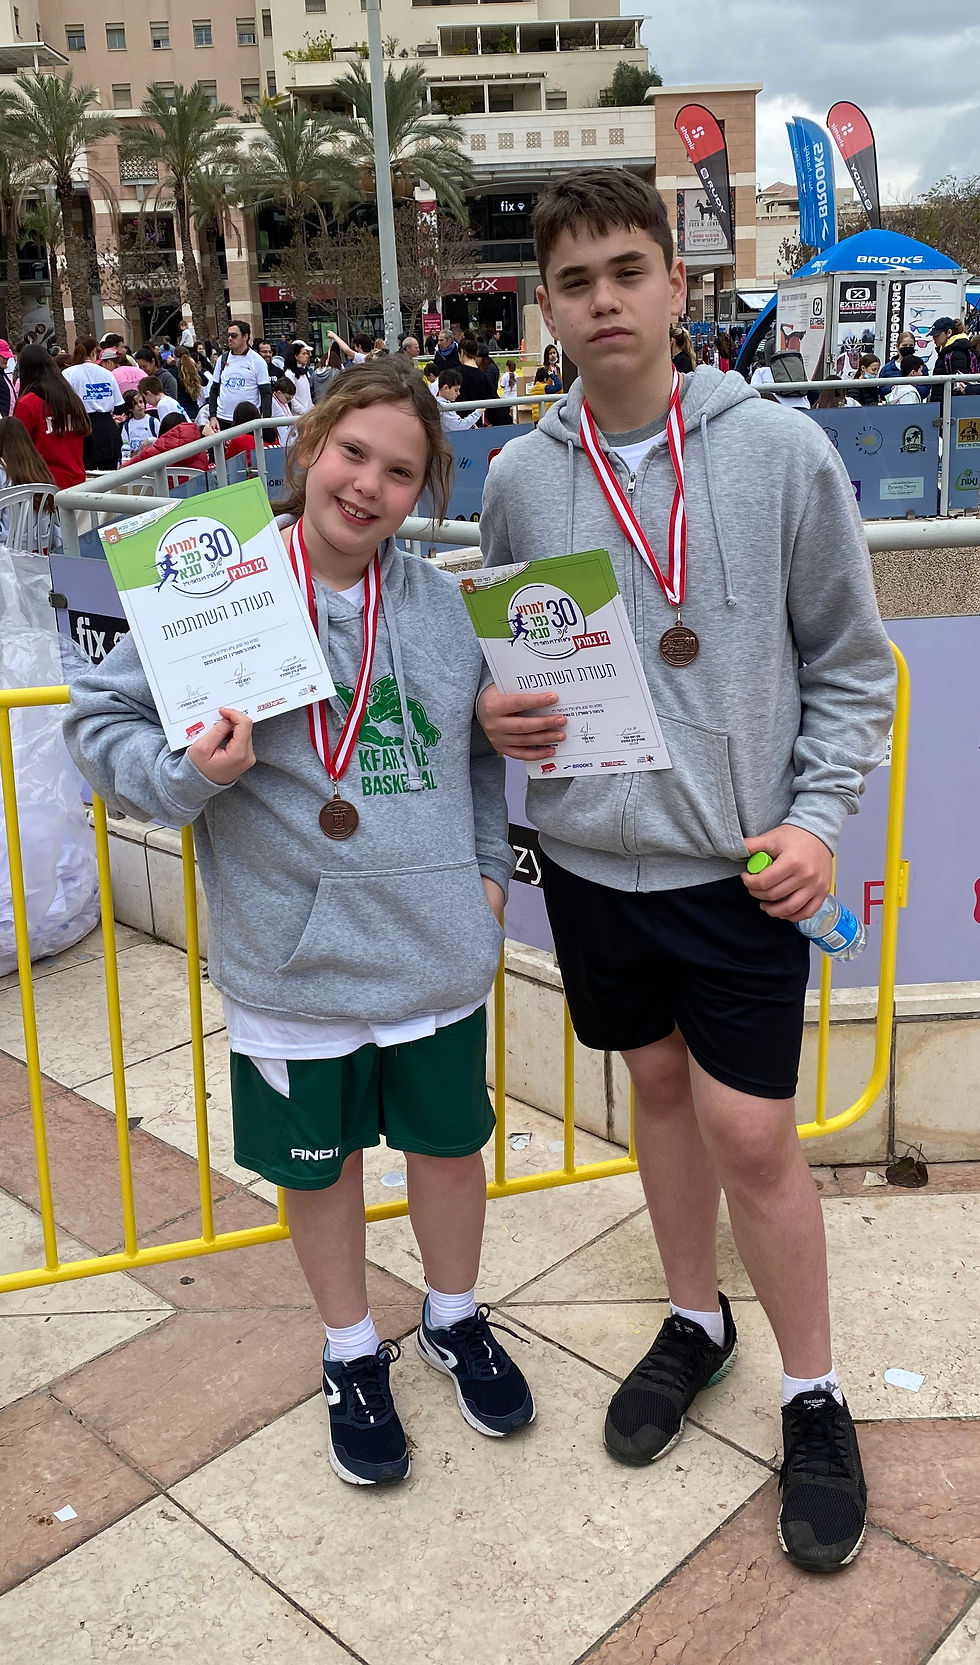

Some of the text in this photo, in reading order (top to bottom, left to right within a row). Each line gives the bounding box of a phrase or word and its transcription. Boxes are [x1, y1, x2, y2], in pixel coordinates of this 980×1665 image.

[679, 125, 695, 151] shamir
[707, 180, 726, 214] RUDY
[500, 201, 515, 212] fix
[856, 255, 923, 264] BROOKS
[460, 279, 498, 291] FOX
[839, 300, 876, 308] EXTREME
[165, 536, 197, 558] למרוץ
[199, 528, 233, 562] 30
[180, 550, 202, 565] כפר
[179, 563, 203, 580] סבא
[230, 558, 266, 580] 12 במרץ
[162, 590, 275, 640] תעודת השתתפות
[516, 601, 545, 616] למרוץ
[546, 597, 577, 628] 30
[530, 615, 549, 627] כפר
[76, 616, 107, 659] fix
[529, 627, 550, 640] סבא
[575, 633, 609, 649] 12 במרץ
[516, 663, 617, 690] תעודת השתתפות
[358, 748, 400, 772] KFAR
[291, 1147, 339, 1161] AND1
[803, 1397, 826, 1405] Reebok
